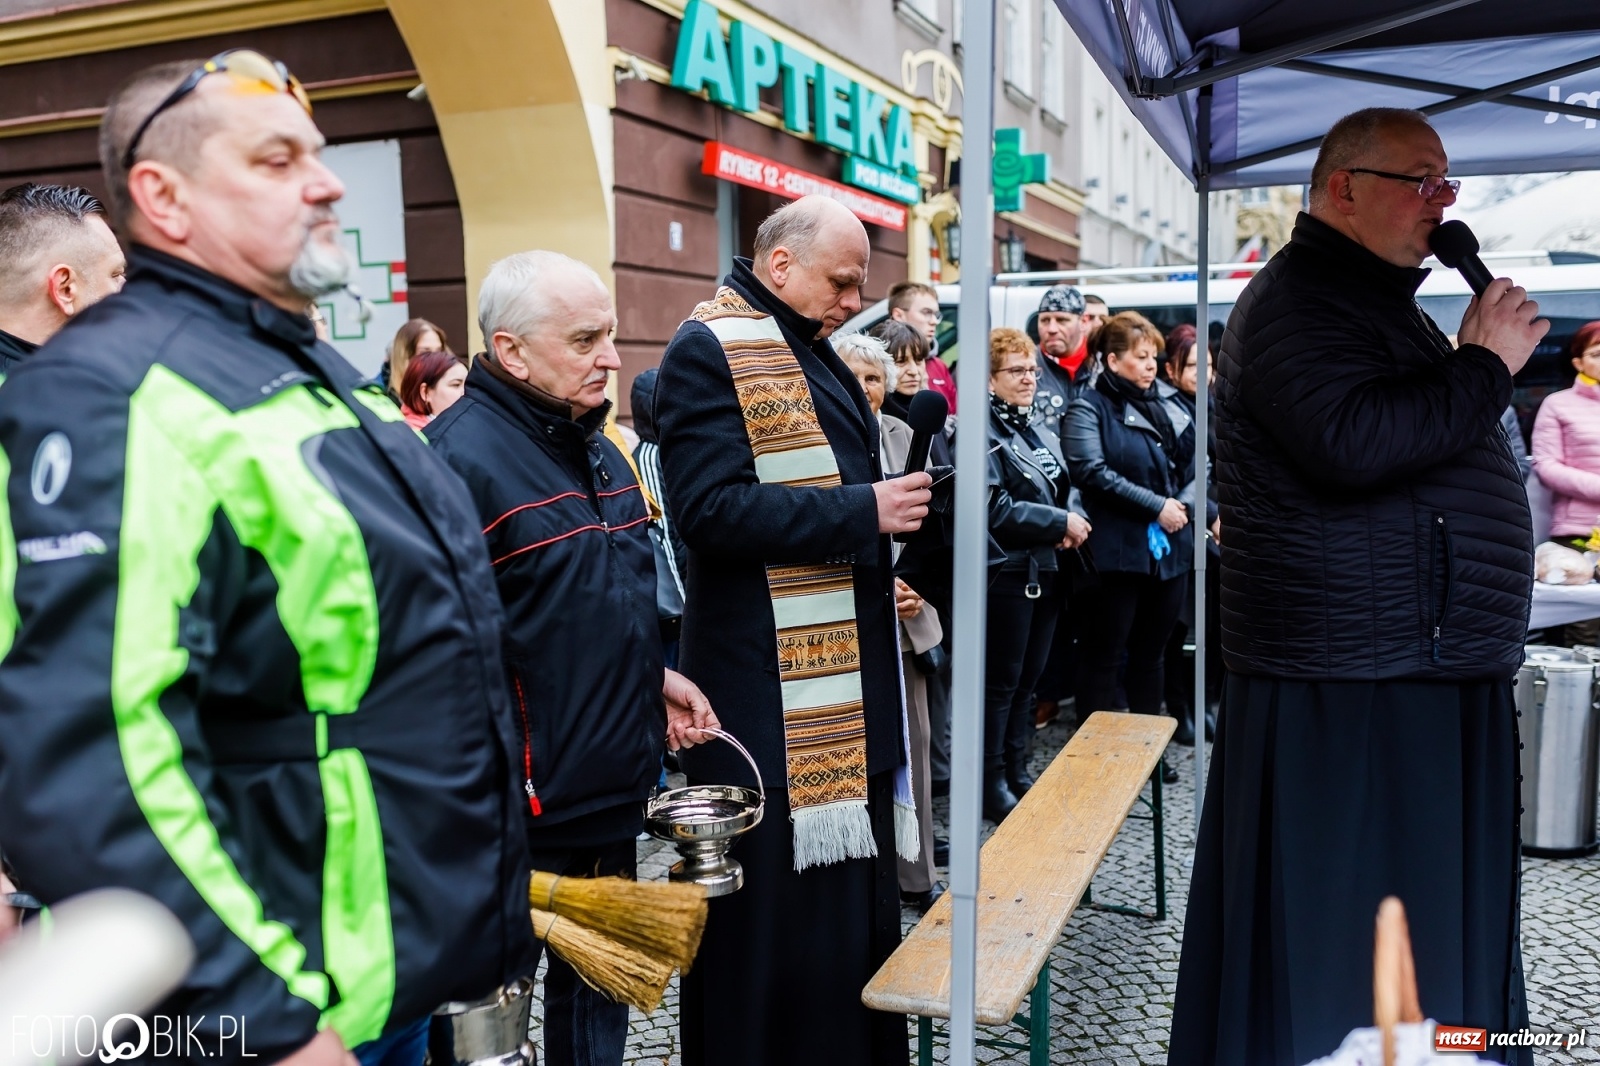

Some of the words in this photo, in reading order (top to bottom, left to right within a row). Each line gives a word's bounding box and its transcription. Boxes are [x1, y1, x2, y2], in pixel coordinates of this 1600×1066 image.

[672, 0, 918, 177] APTEKA
[719, 150, 764, 184] RYNEK
[763, 165, 779, 188] 12
